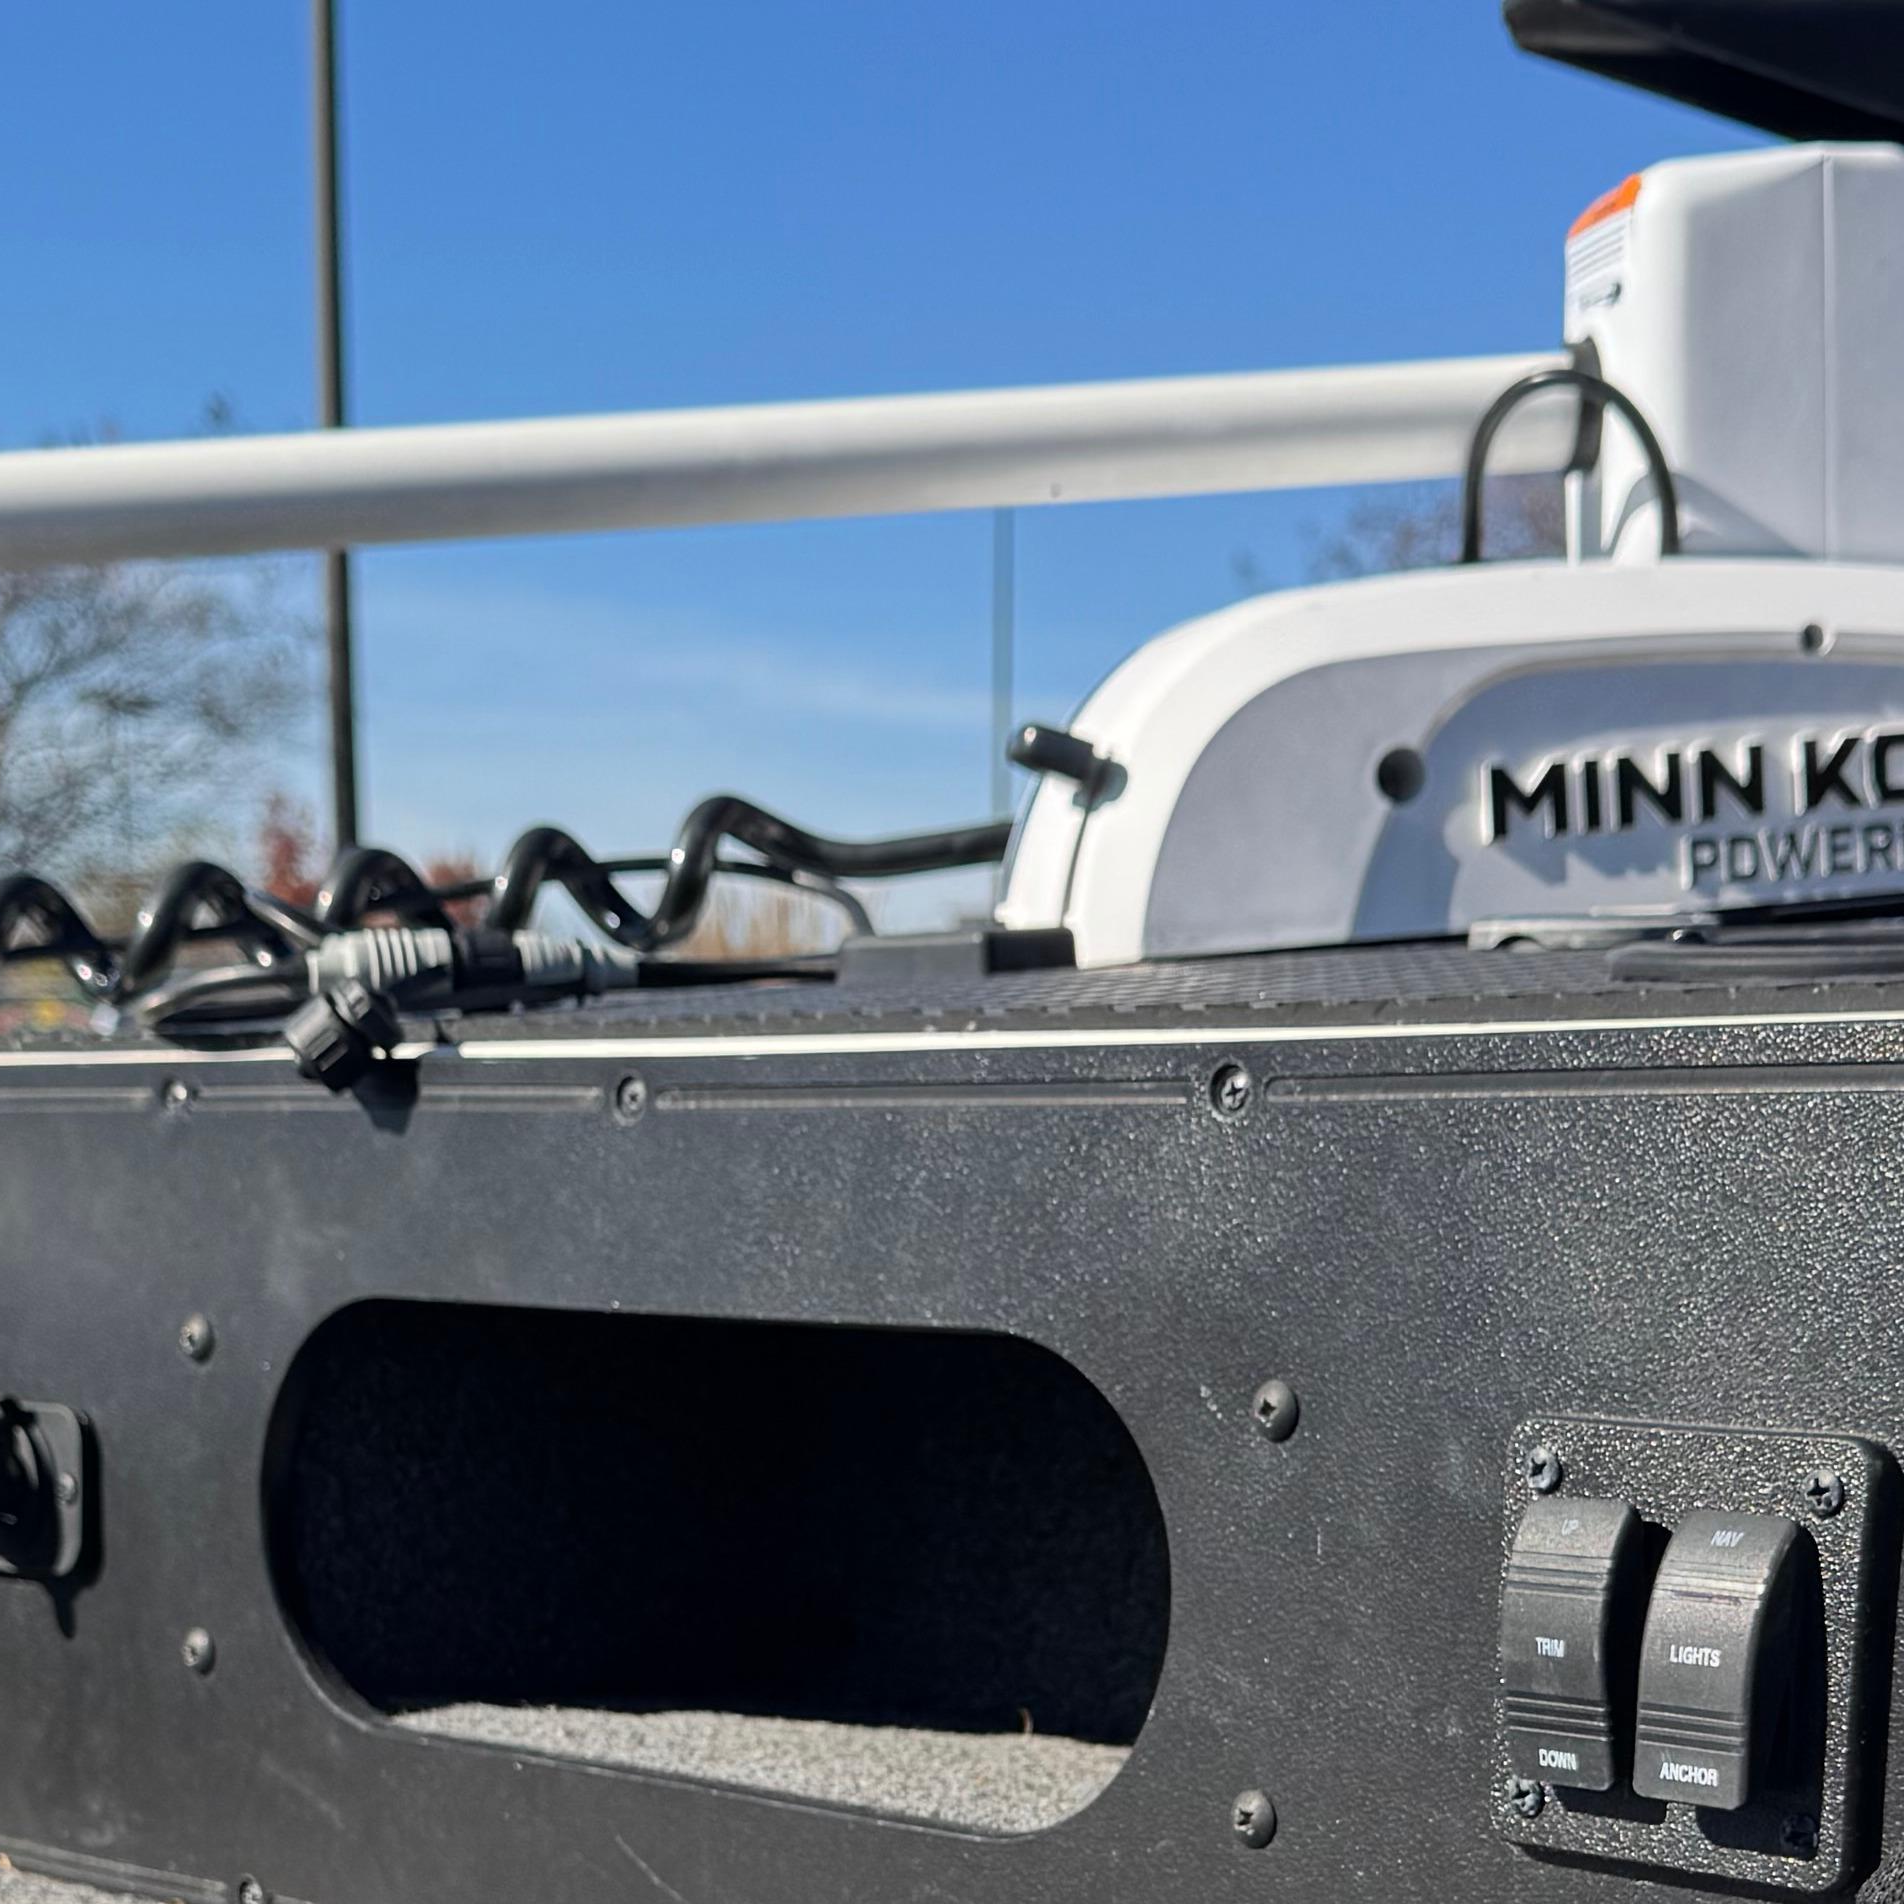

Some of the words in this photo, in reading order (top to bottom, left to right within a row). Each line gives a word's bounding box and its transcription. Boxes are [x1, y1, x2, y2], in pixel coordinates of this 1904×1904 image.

[1483, 743, 1764, 845] MINN
[1562, 1520, 1579, 1535] UP
[1711, 1530, 1744, 1548] NAV
[1535, 1636, 1565, 1658] TRIM
[1669, 1644, 1722, 1668] LIGHTS
[1538, 1748, 1578, 1771] DOWN
[1659, 1762, 1718, 1787] ANCHOR
